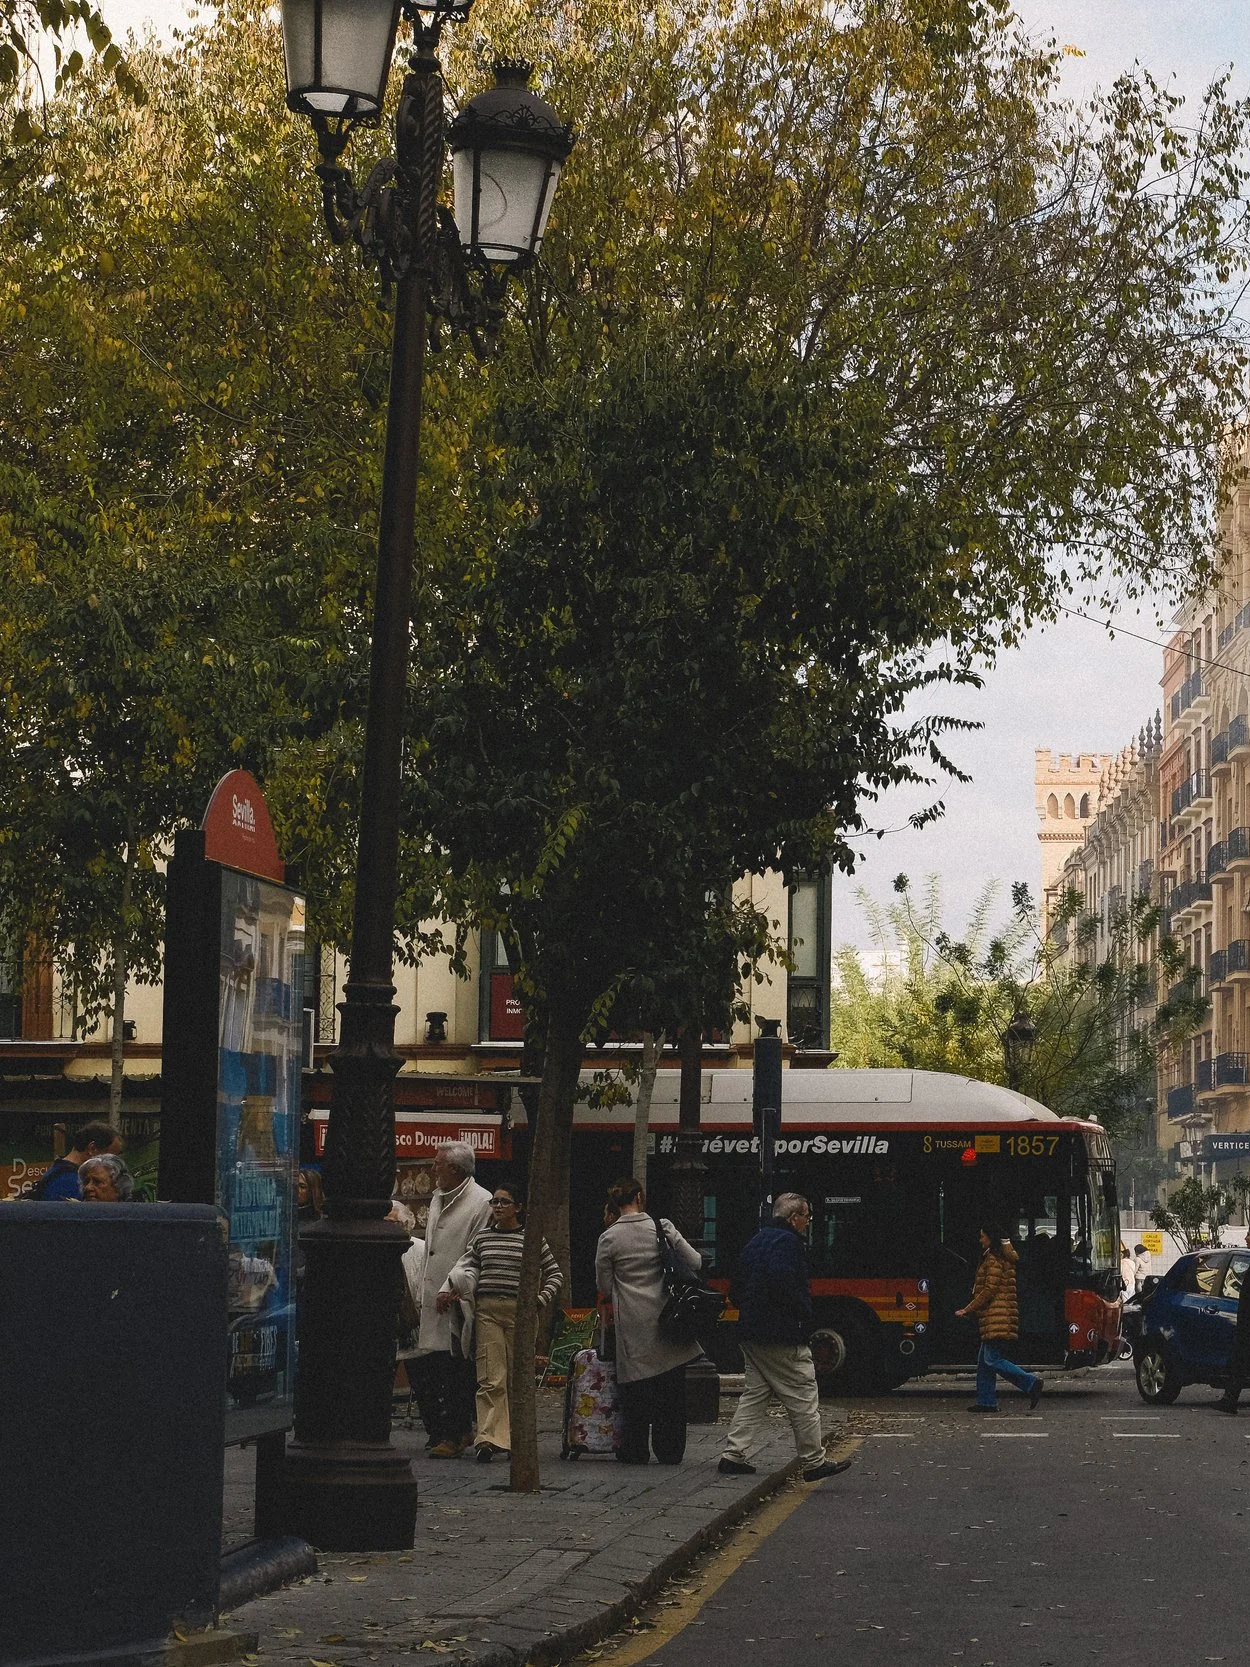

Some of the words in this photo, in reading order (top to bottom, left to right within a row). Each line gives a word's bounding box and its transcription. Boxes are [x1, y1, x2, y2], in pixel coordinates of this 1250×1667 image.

[436, 1086, 474, 1097] WELCOME
[461, 1131, 493, 1150] ¡HOLA!
[935, 1140, 972, 1148] TUSSAM
[1006, 1135, 1060, 1156] 1857
[1212, 1142, 1250, 1150] VERTICE
